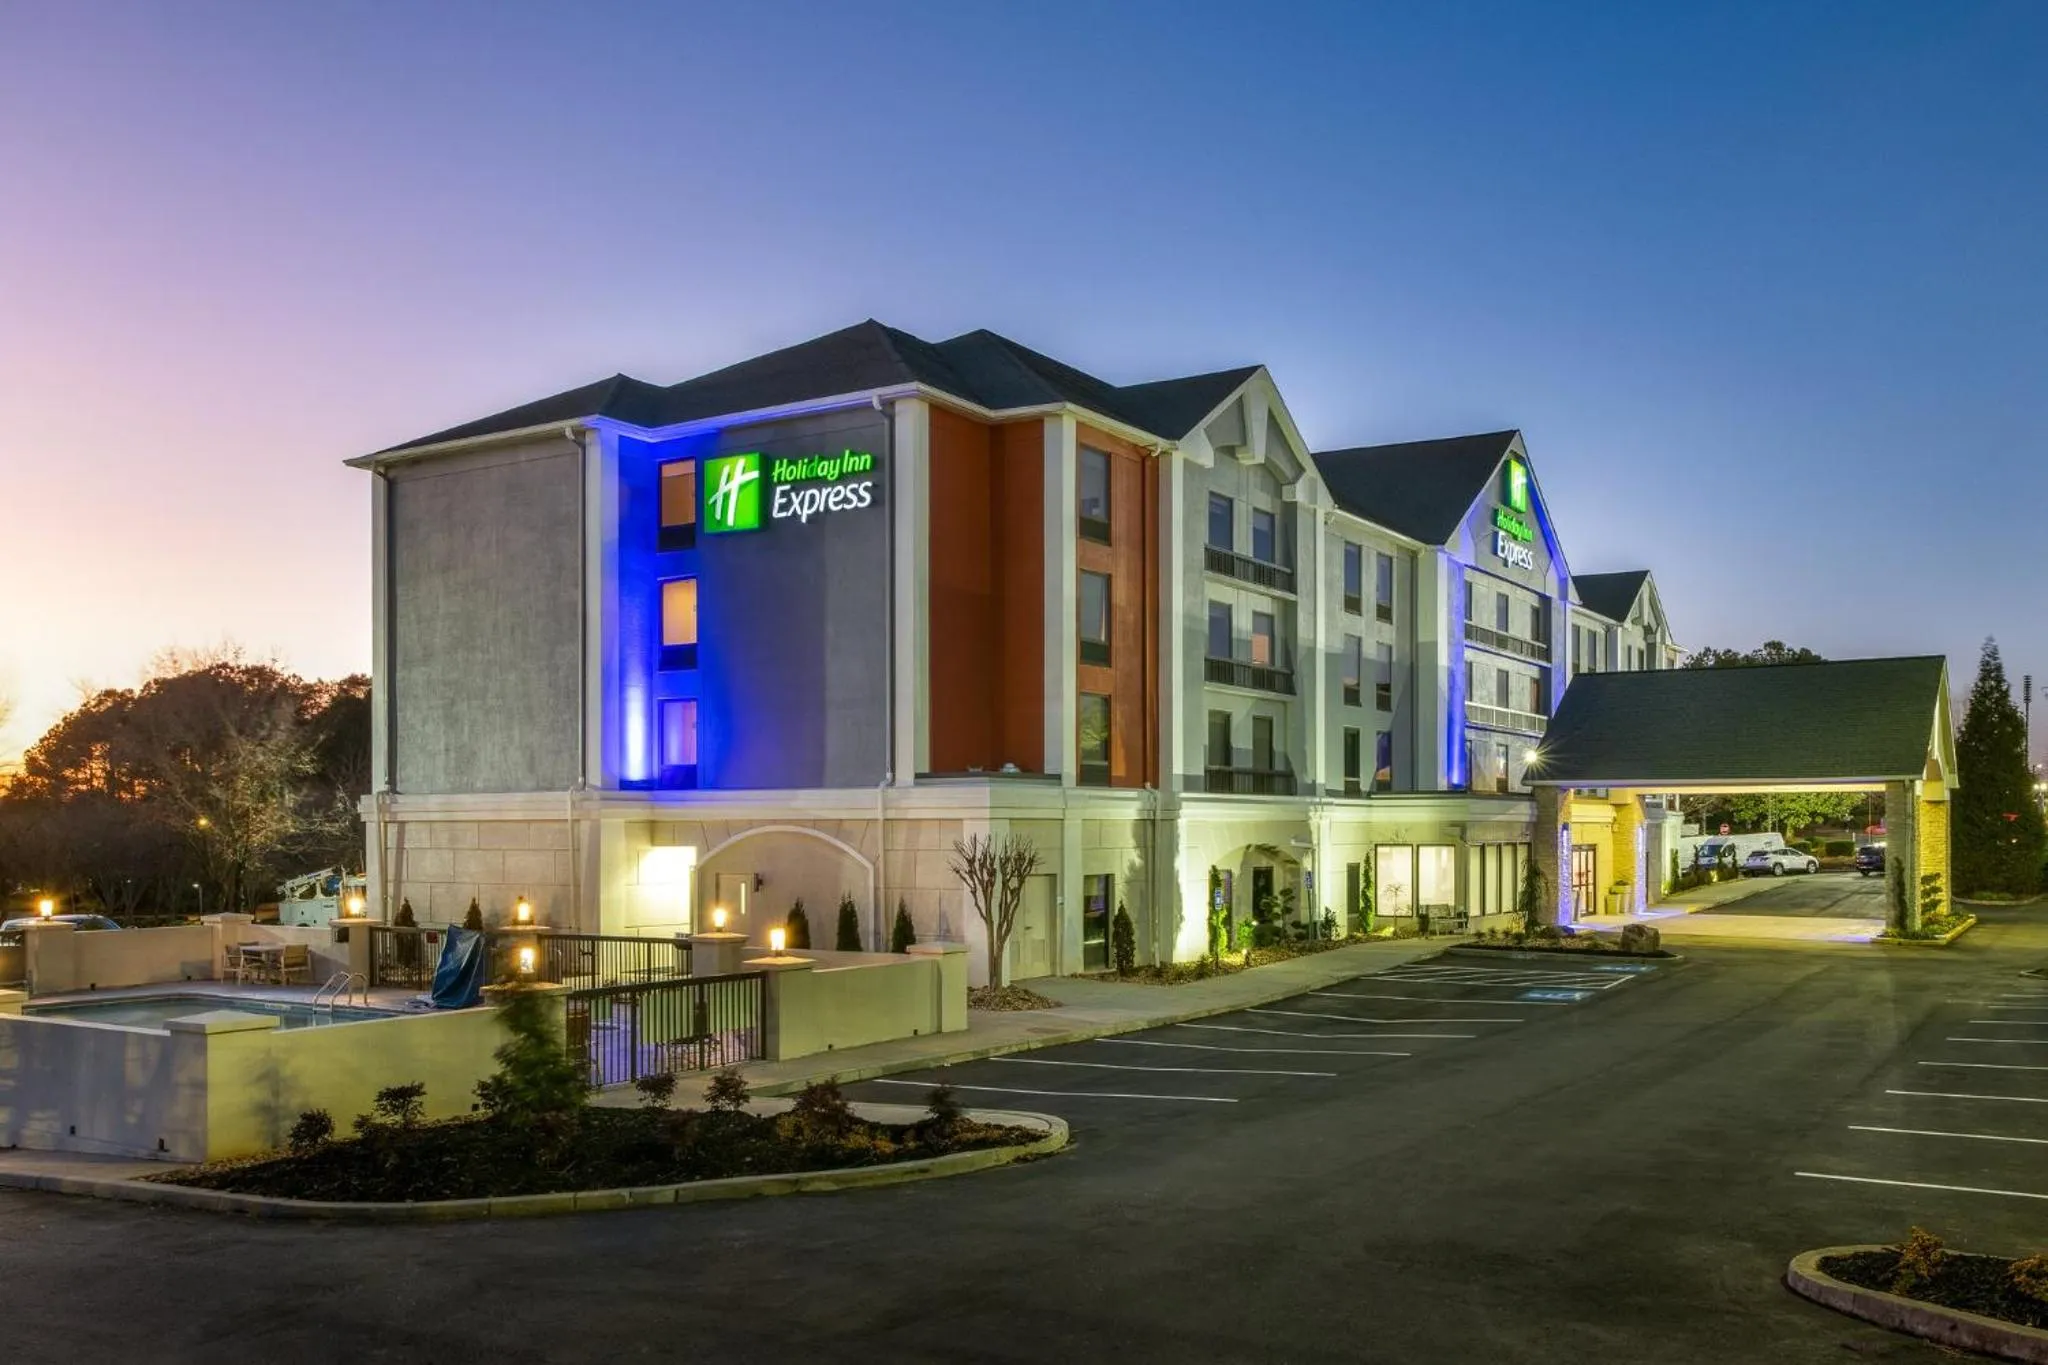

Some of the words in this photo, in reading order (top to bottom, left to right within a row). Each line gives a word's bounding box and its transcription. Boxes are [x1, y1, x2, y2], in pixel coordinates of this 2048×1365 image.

[772, 455, 840, 482] Holiday
[843, 449, 872, 473] Inn
[772, 481, 873, 523] Express
[1497, 530, 1533, 570] Express
